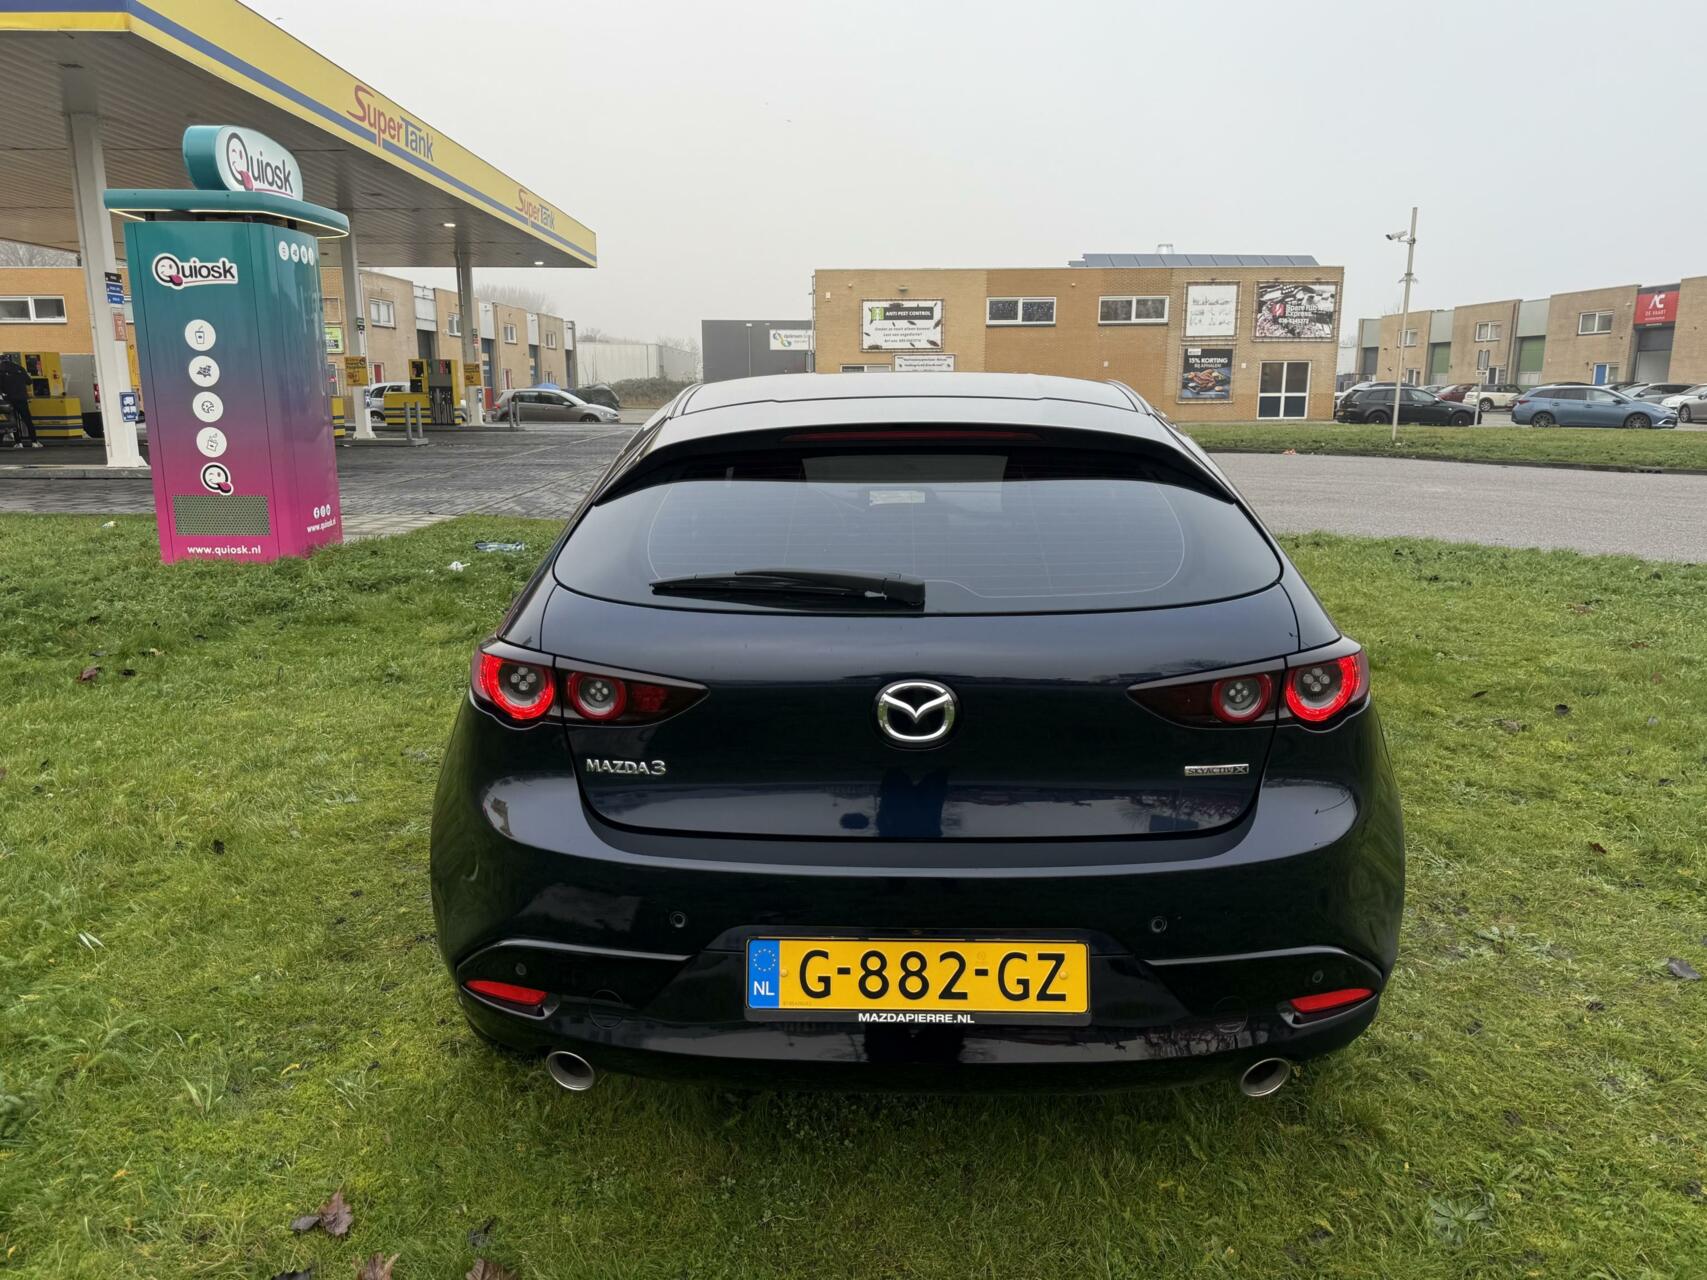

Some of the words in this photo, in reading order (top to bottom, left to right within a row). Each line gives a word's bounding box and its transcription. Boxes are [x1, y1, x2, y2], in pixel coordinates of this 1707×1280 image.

[226, 132, 293, 194] Quiosk
[154, 256, 236, 285] Quiosk
[187, 544, 262, 556] www.quiosk.nl
[798, 949, 1067, 1002] G-882-GZ
[752, 980, 775, 996] NL
[857, 1012, 975, 1024] MAZDAPIERRE.NL
